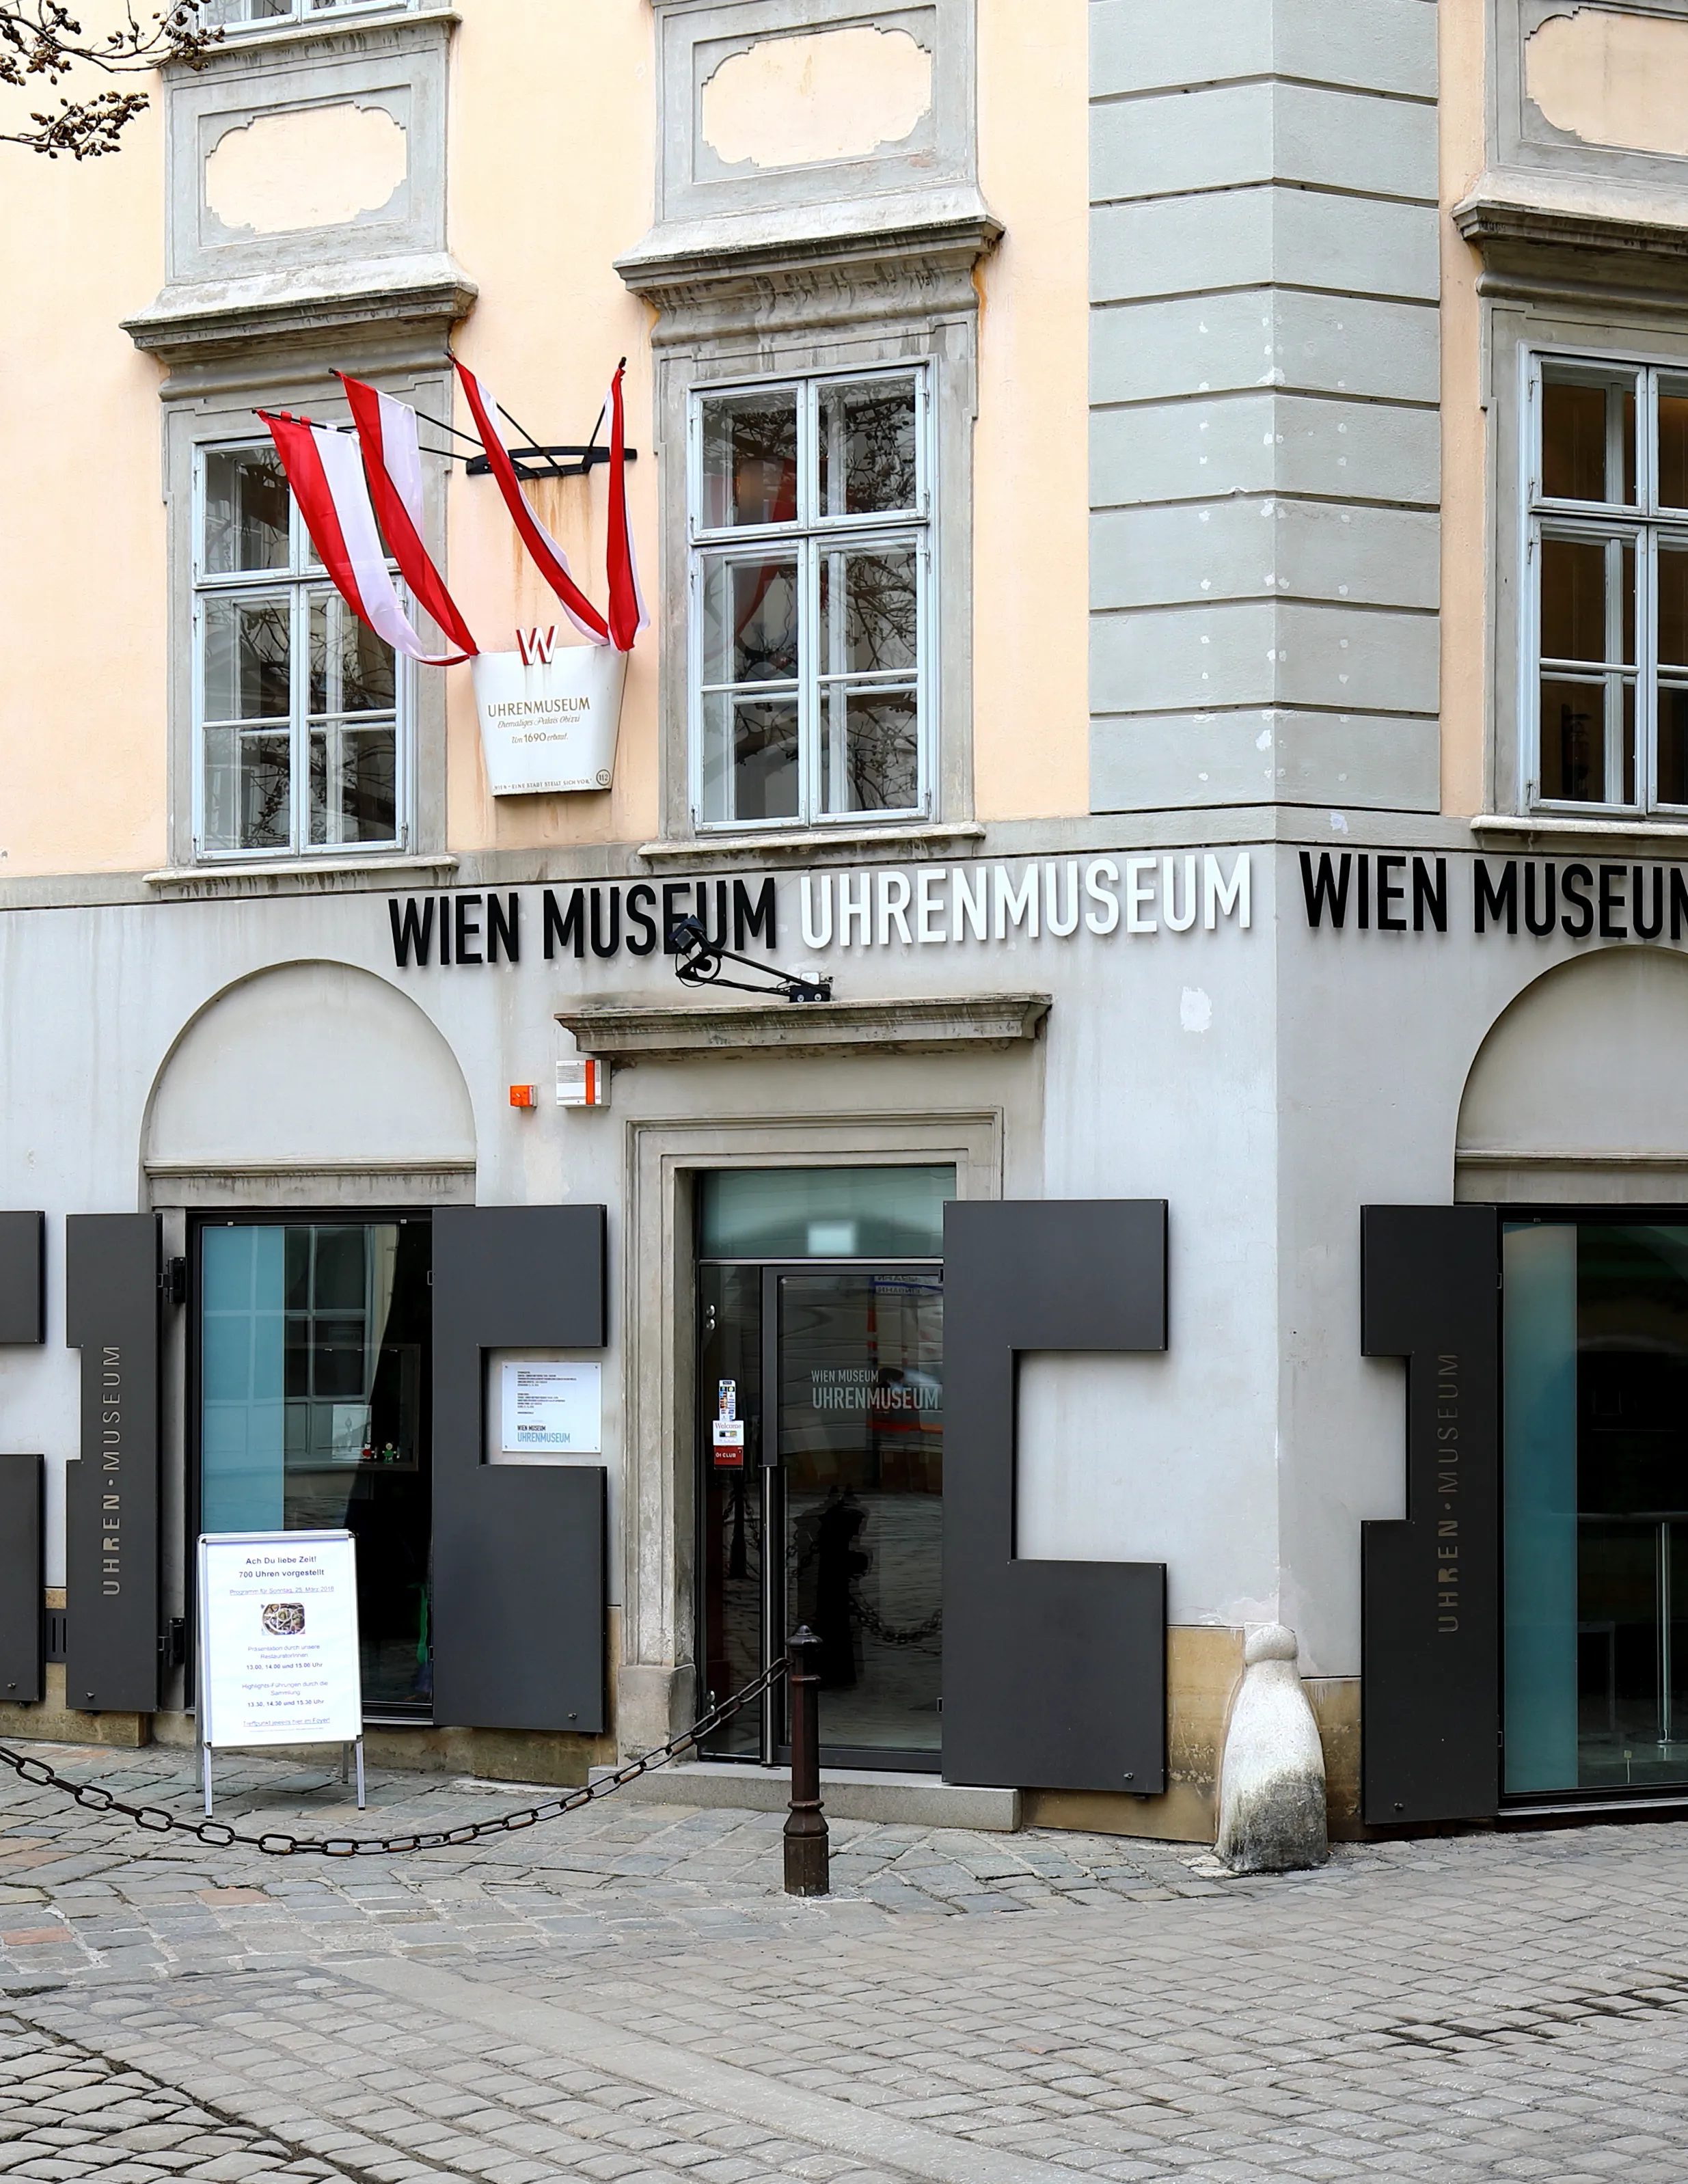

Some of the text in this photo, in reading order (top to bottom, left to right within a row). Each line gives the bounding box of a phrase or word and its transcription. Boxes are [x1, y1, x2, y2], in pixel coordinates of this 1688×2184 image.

[516, 625, 559, 666] W
[488, 697, 590, 718] UHRENMUSEUM
[498, 720, 533, 728] Ehemaliges
[534, 716, 558, 725] Palais
[523, 732, 546, 743] 1690
[599, 774, 608, 782] 112
[1298, 851, 1447, 932] WIEN
[388, 852, 1251, 967] WIEN MUSEUM UHRENMUSEUM
[811, 1369, 879, 1382] WIEN MUSEUM
[813, 1387, 938, 1409] UHRENMUSEUM
[517, 1432, 571, 1443] UHRENMUSEUM
[282, 1569, 325, 1577] vorgestellt
